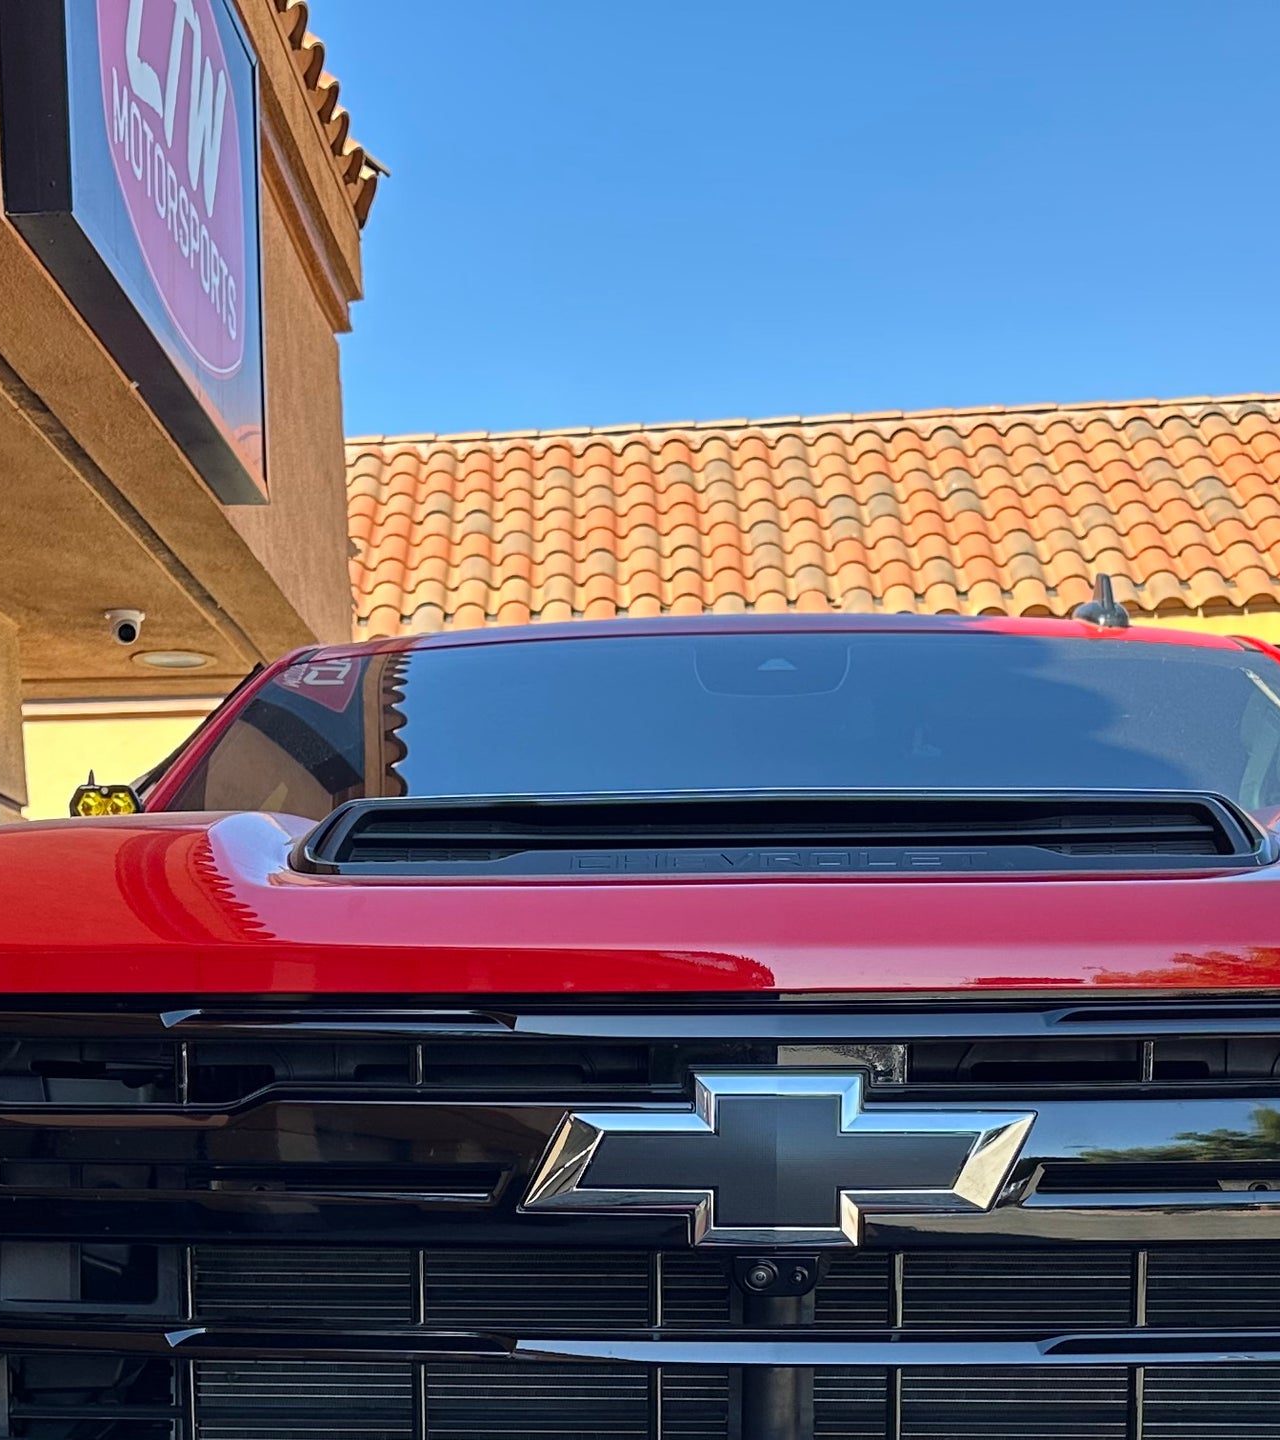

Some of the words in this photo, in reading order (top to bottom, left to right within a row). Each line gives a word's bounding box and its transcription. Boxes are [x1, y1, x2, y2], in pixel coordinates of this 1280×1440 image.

[112, 66, 237, 341] MOTORSPORTS
[125, 0, 227, 218] LTW
[569, 851, 988, 871] CHEVROLET
